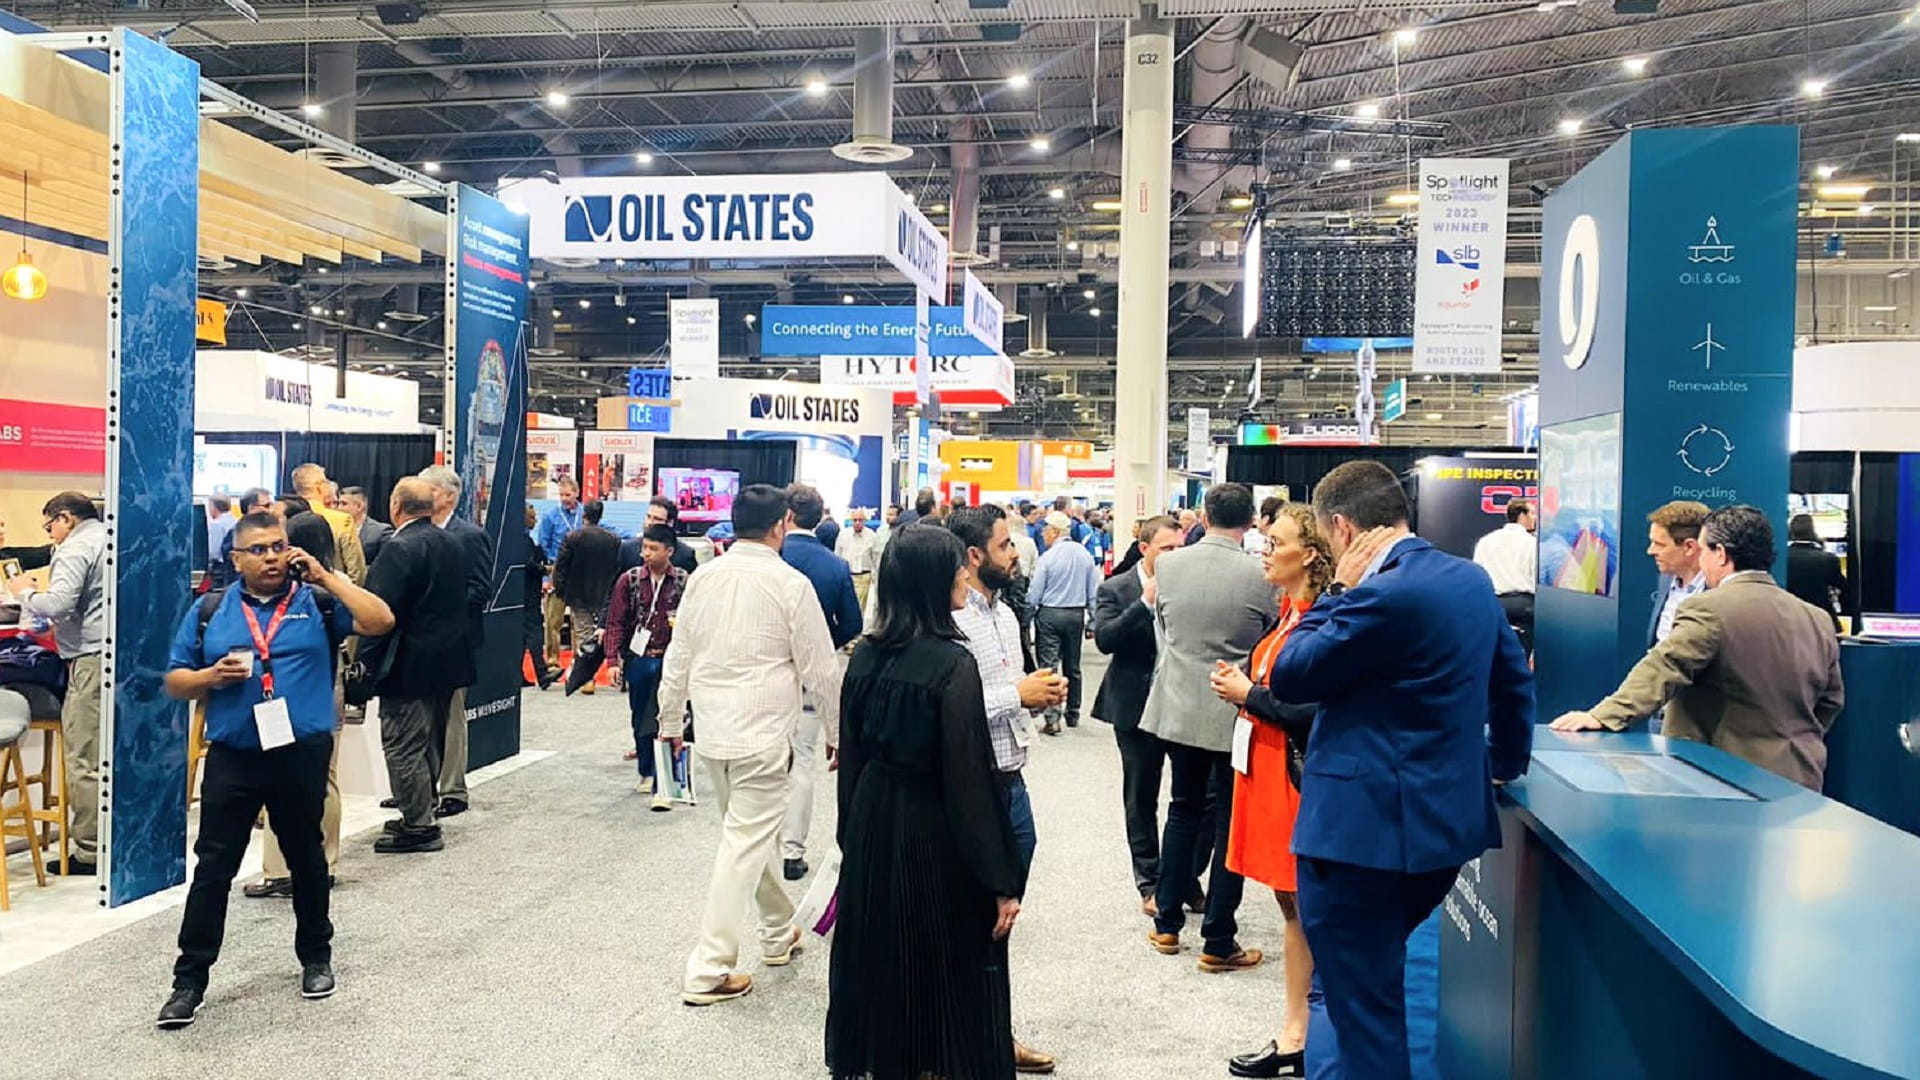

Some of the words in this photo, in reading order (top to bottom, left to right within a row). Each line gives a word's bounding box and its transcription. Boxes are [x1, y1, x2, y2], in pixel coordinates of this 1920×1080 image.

[1138, 54, 1159, 65] C32
[619, 194, 674, 242] OIL
[682, 193, 814, 242] STATES
[1446, 208, 1478, 218] 2023
[1433, 222, 1489, 232] WINNER
[1453, 245, 1480, 260] slb
[1680, 272, 1700, 285] Oil
[1703, 272, 1713, 284] &
[1716, 272, 1742, 285] Gas
[772, 322, 851, 339] Connecting
[856, 322, 878, 336] the
[935, 323, 974, 336] Futu
[1668, 379, 1748, 392] Renewables
[775, 396, 799, 420] OIL
[803, 397, 859, 423] STATES
[1673, 485, 1737, 500] Recycling
